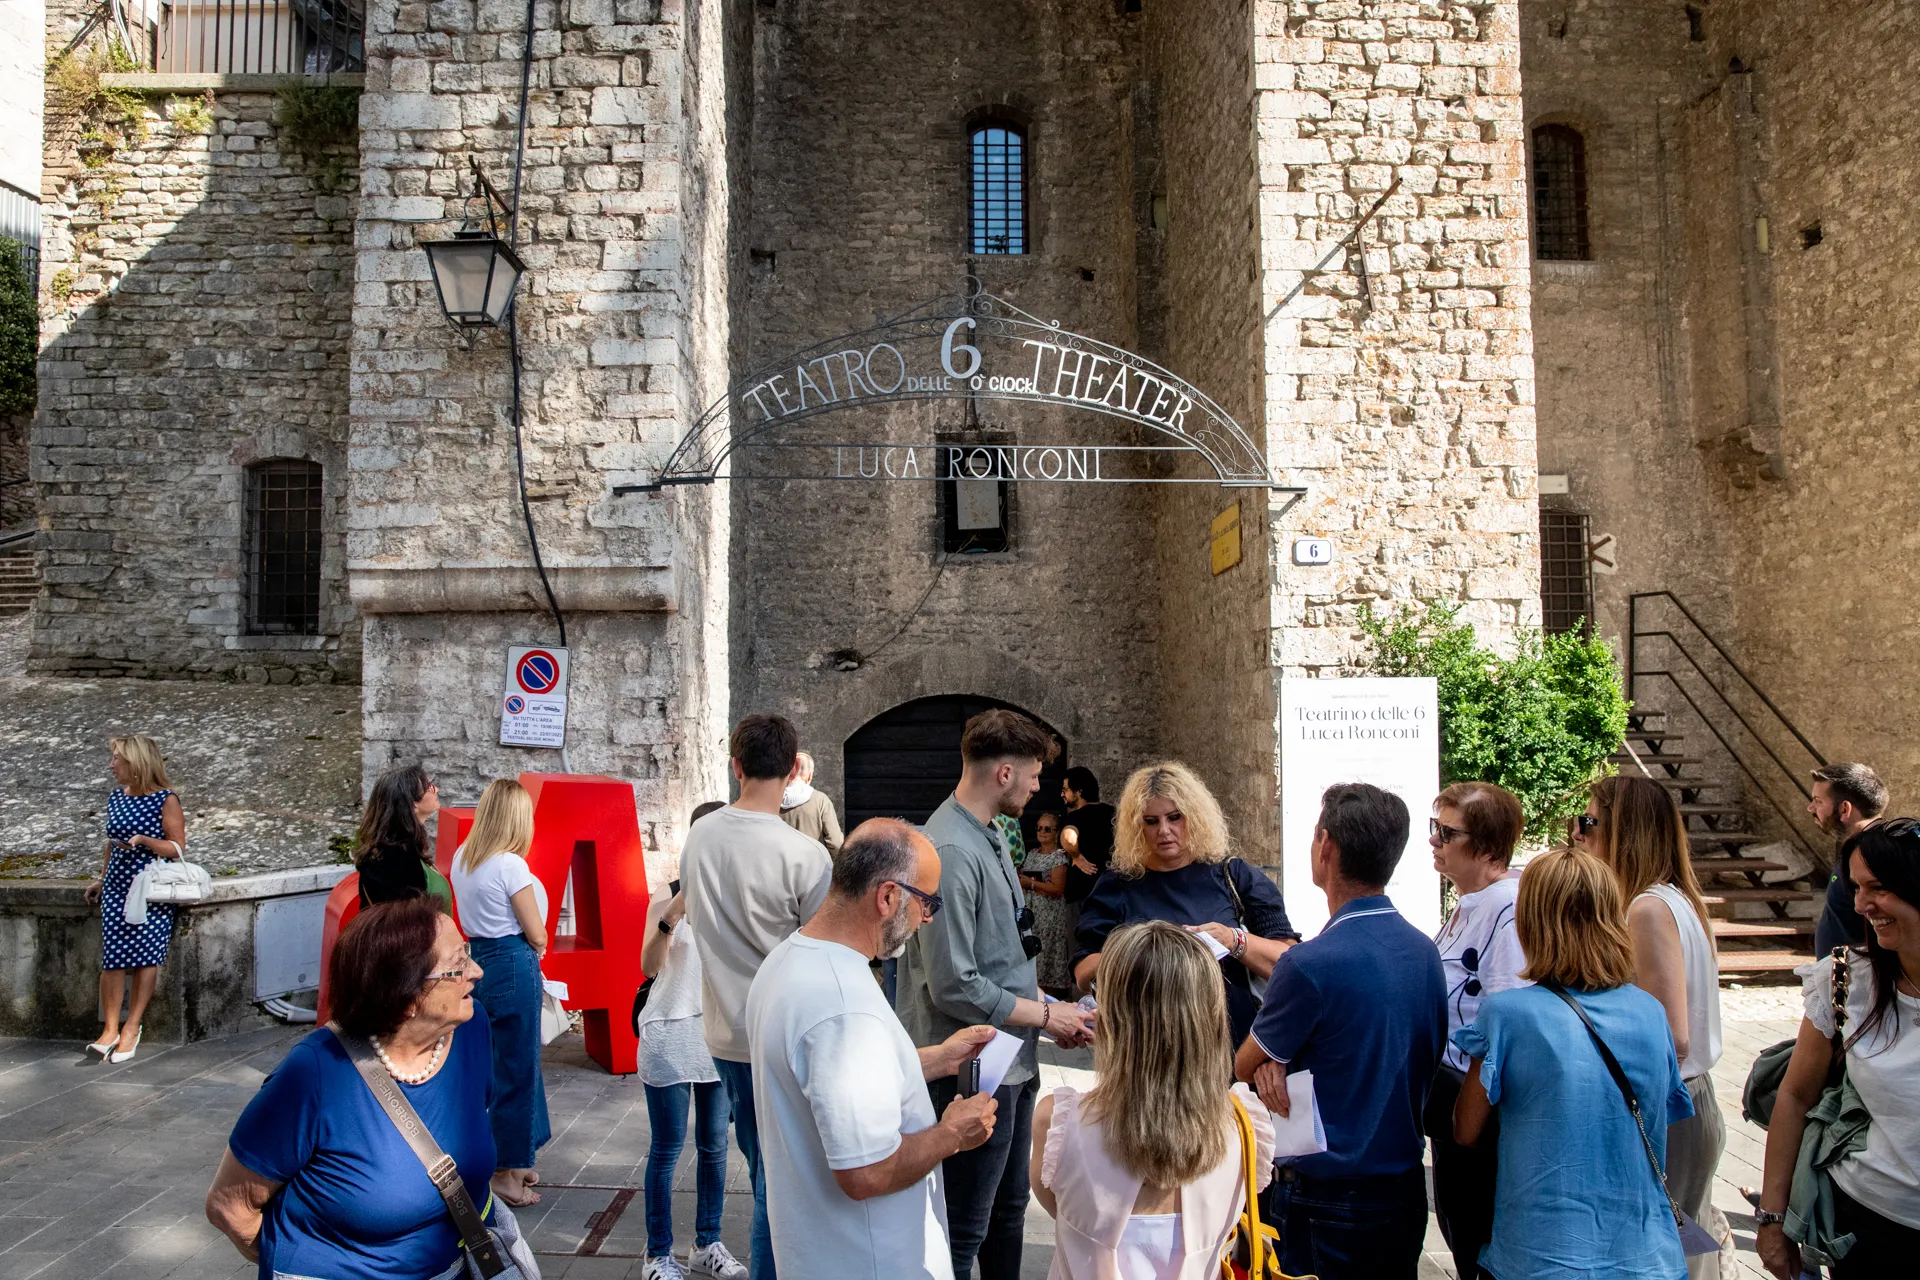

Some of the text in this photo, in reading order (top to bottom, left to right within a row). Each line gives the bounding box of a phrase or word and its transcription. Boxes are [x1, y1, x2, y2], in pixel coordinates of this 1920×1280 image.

[743, 343, 906, 423] TEATRO
[907, 376, 952, 393] DELLE
[940, 316, 982, 379] 6
[1023, 340, 1194, 432] THEATER
[836, 447, 1103, 480] LUCA RONCONI
[1309, 543, 1319, 558] 6
[1295, 705, 1426, 722] Teatrino delle 6
[1301, 725, 1420, 740] Luca Ronconi
[370, 1068, 420, 1138] BORBONESE
